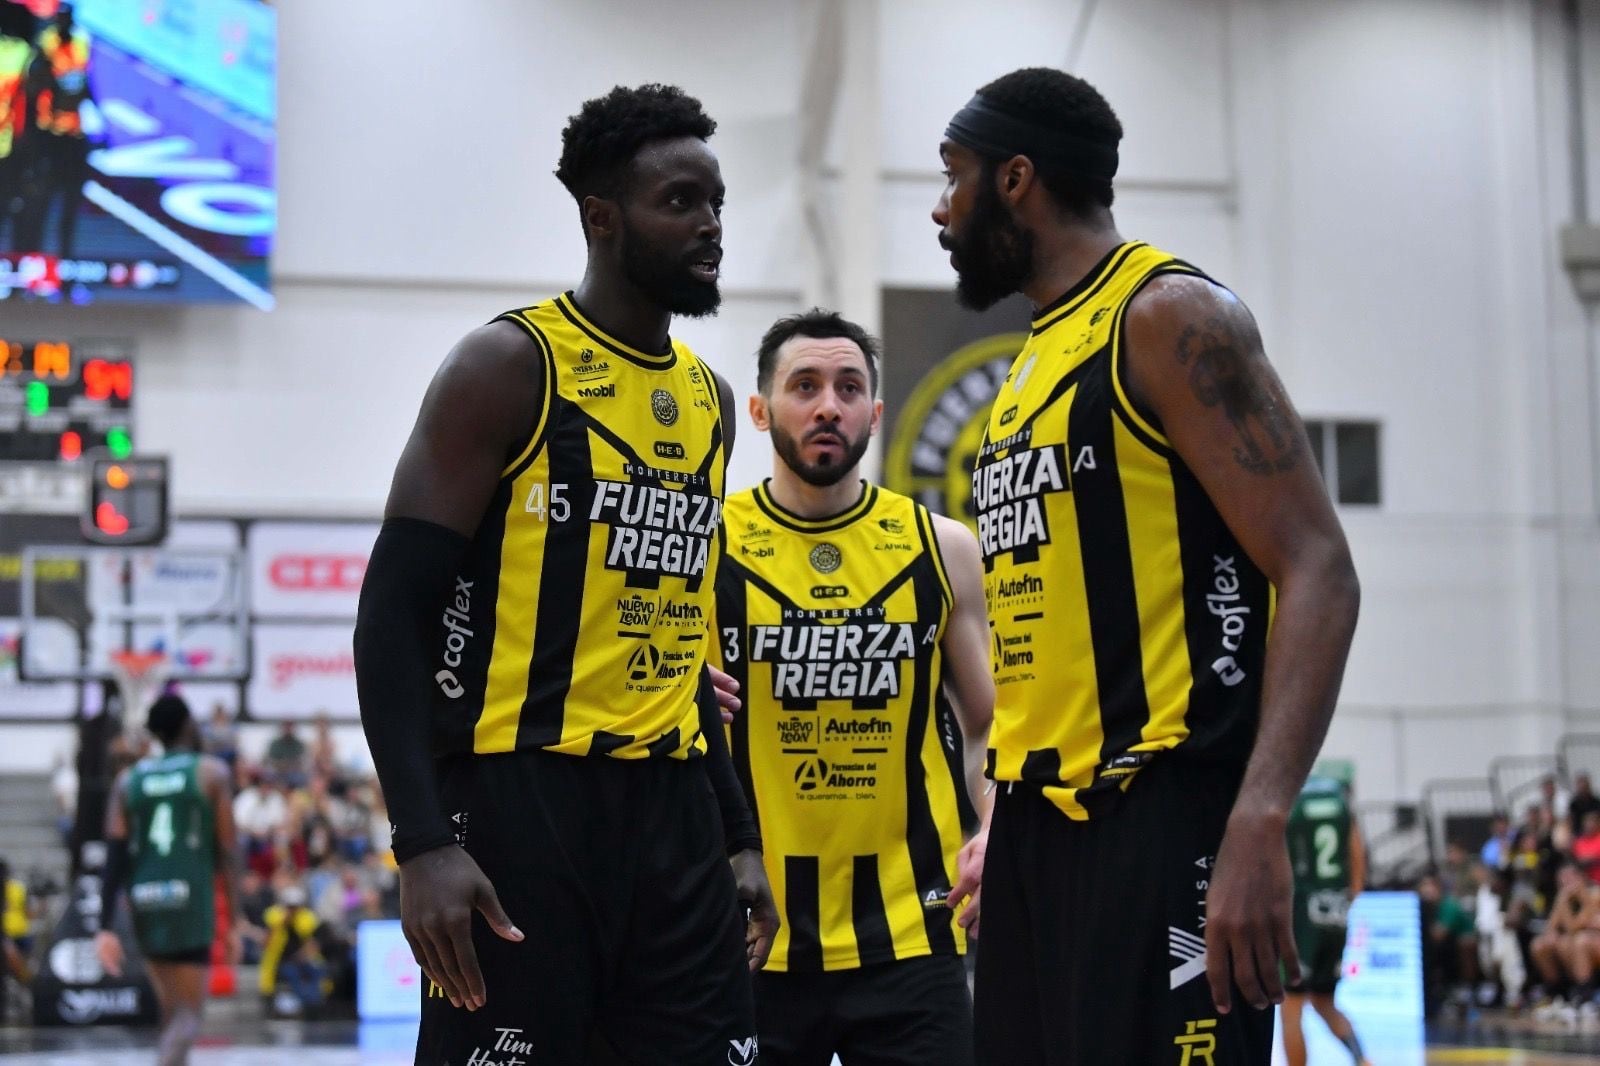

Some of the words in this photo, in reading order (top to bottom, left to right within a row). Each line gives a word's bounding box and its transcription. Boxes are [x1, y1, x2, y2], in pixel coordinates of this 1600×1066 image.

[577, 384, 615, 397] Mobil
[626, 464, 705, 485] MONTERREY
[973, 446, 1063, 511] FUERZA
[524, 484, 571, 522] 45
[589, 480, 723, 535] FUERZA
[978, 499, 1047, 557] REGIA
[607, 526, 709, 576] REGIA
[998, 573, 1043, 599] Autofin
[1206, 554, 1250, 652] coflex
[443, 576, 474, 667] coflex
[784, 607, 884, 618] MONTERREY
[723, 627, 740, 662] 3
[753, 624, 914, 660] FUERZA
[1003, 650, 1033, 668] Ahorro
[656, 663, 691, 679] Ahorr
[775, 661, 898, 698] REGIA
[826, 717, 892, 734] Autofin
[826, 774, 876, 787] Ahorro
[832, 763, 864, 771] Farmacias
[866, 762, 876, 770] del
[148, 802, 176, 856] 4
[1313, 825, 1342, 879] 2
[494, 1027, 533, 1055] Tim
